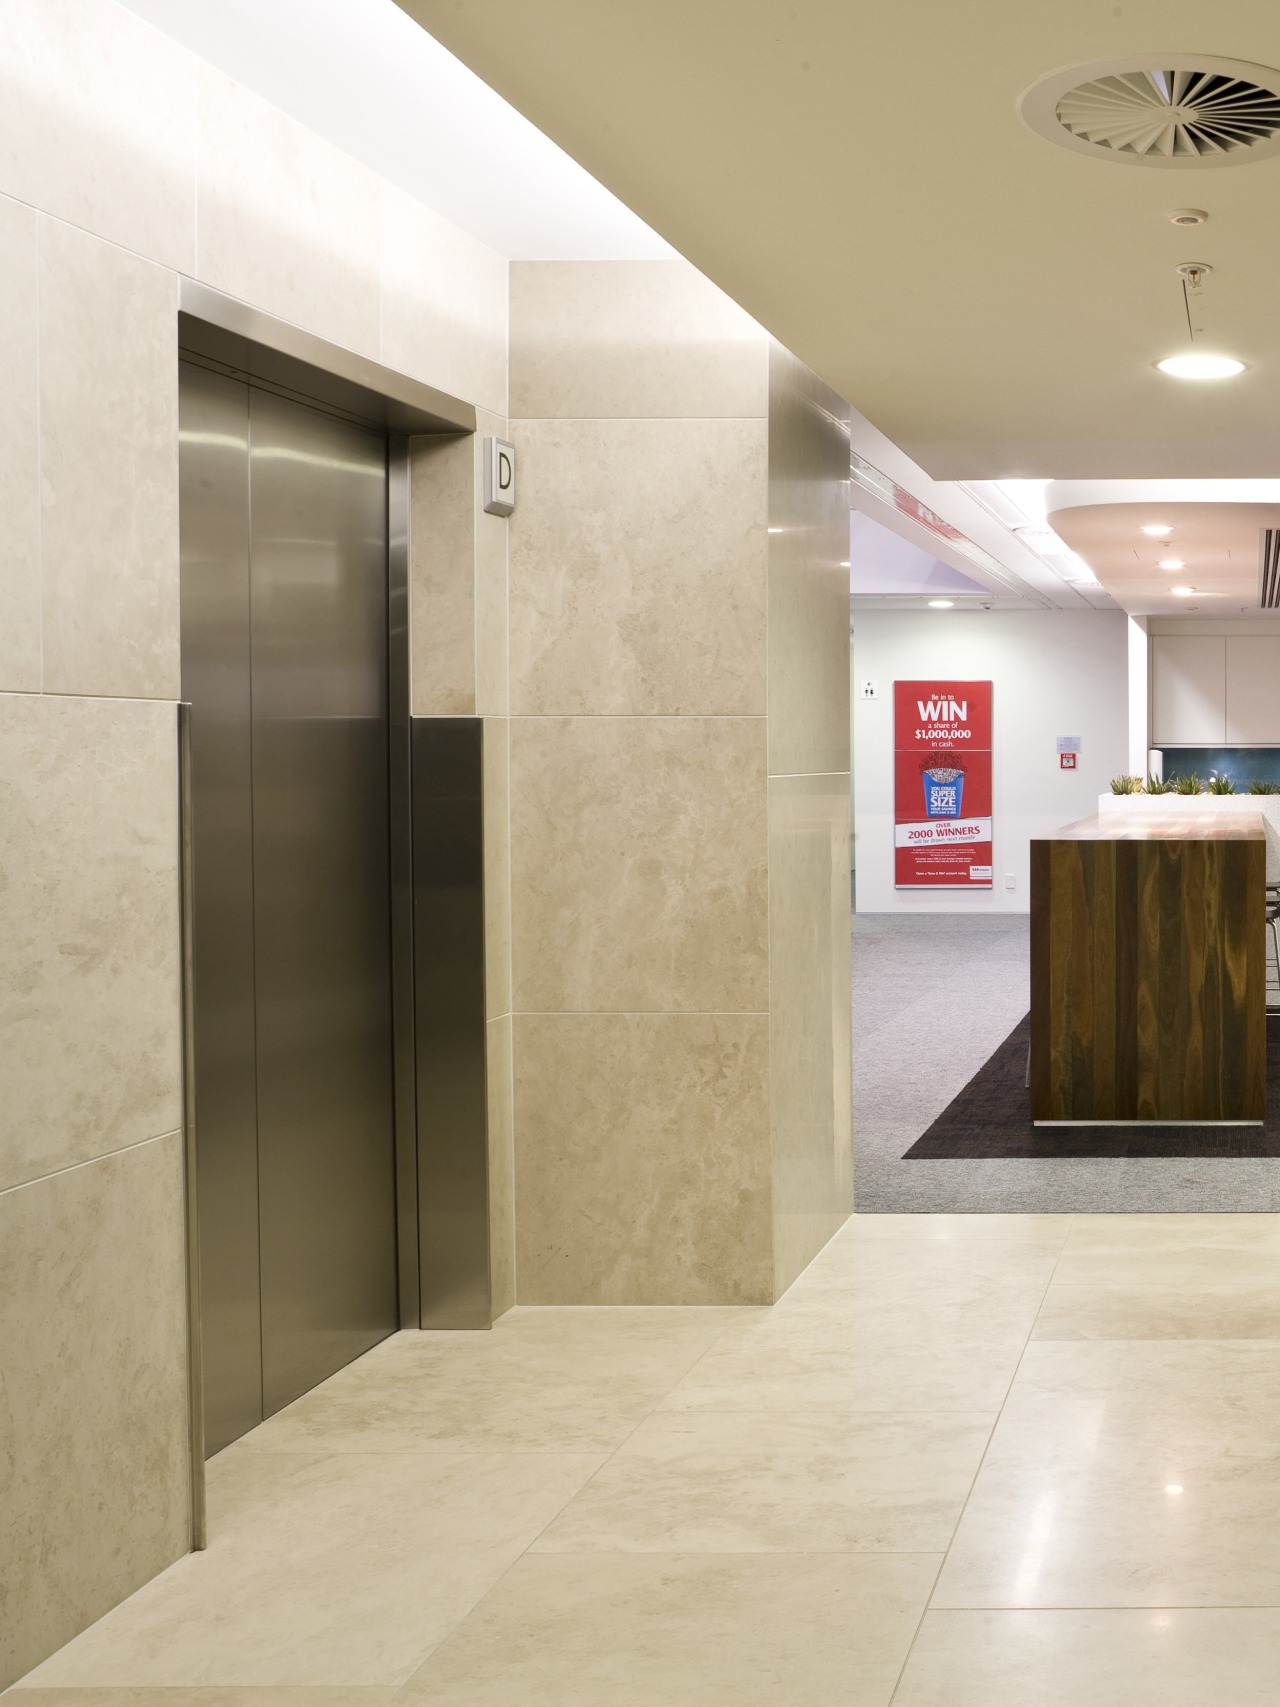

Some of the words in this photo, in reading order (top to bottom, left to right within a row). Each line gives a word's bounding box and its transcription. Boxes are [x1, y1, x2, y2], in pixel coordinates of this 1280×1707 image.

[499, 451, 511, 489] D
[917, 700, 967, 721] WIN
[915, 729, 971, 740] $1,000,000
[930, 797, 956, 807] SIZE
[908, 830, 933, 839] 2000
[936, 826, 981, 837] WINNERS
